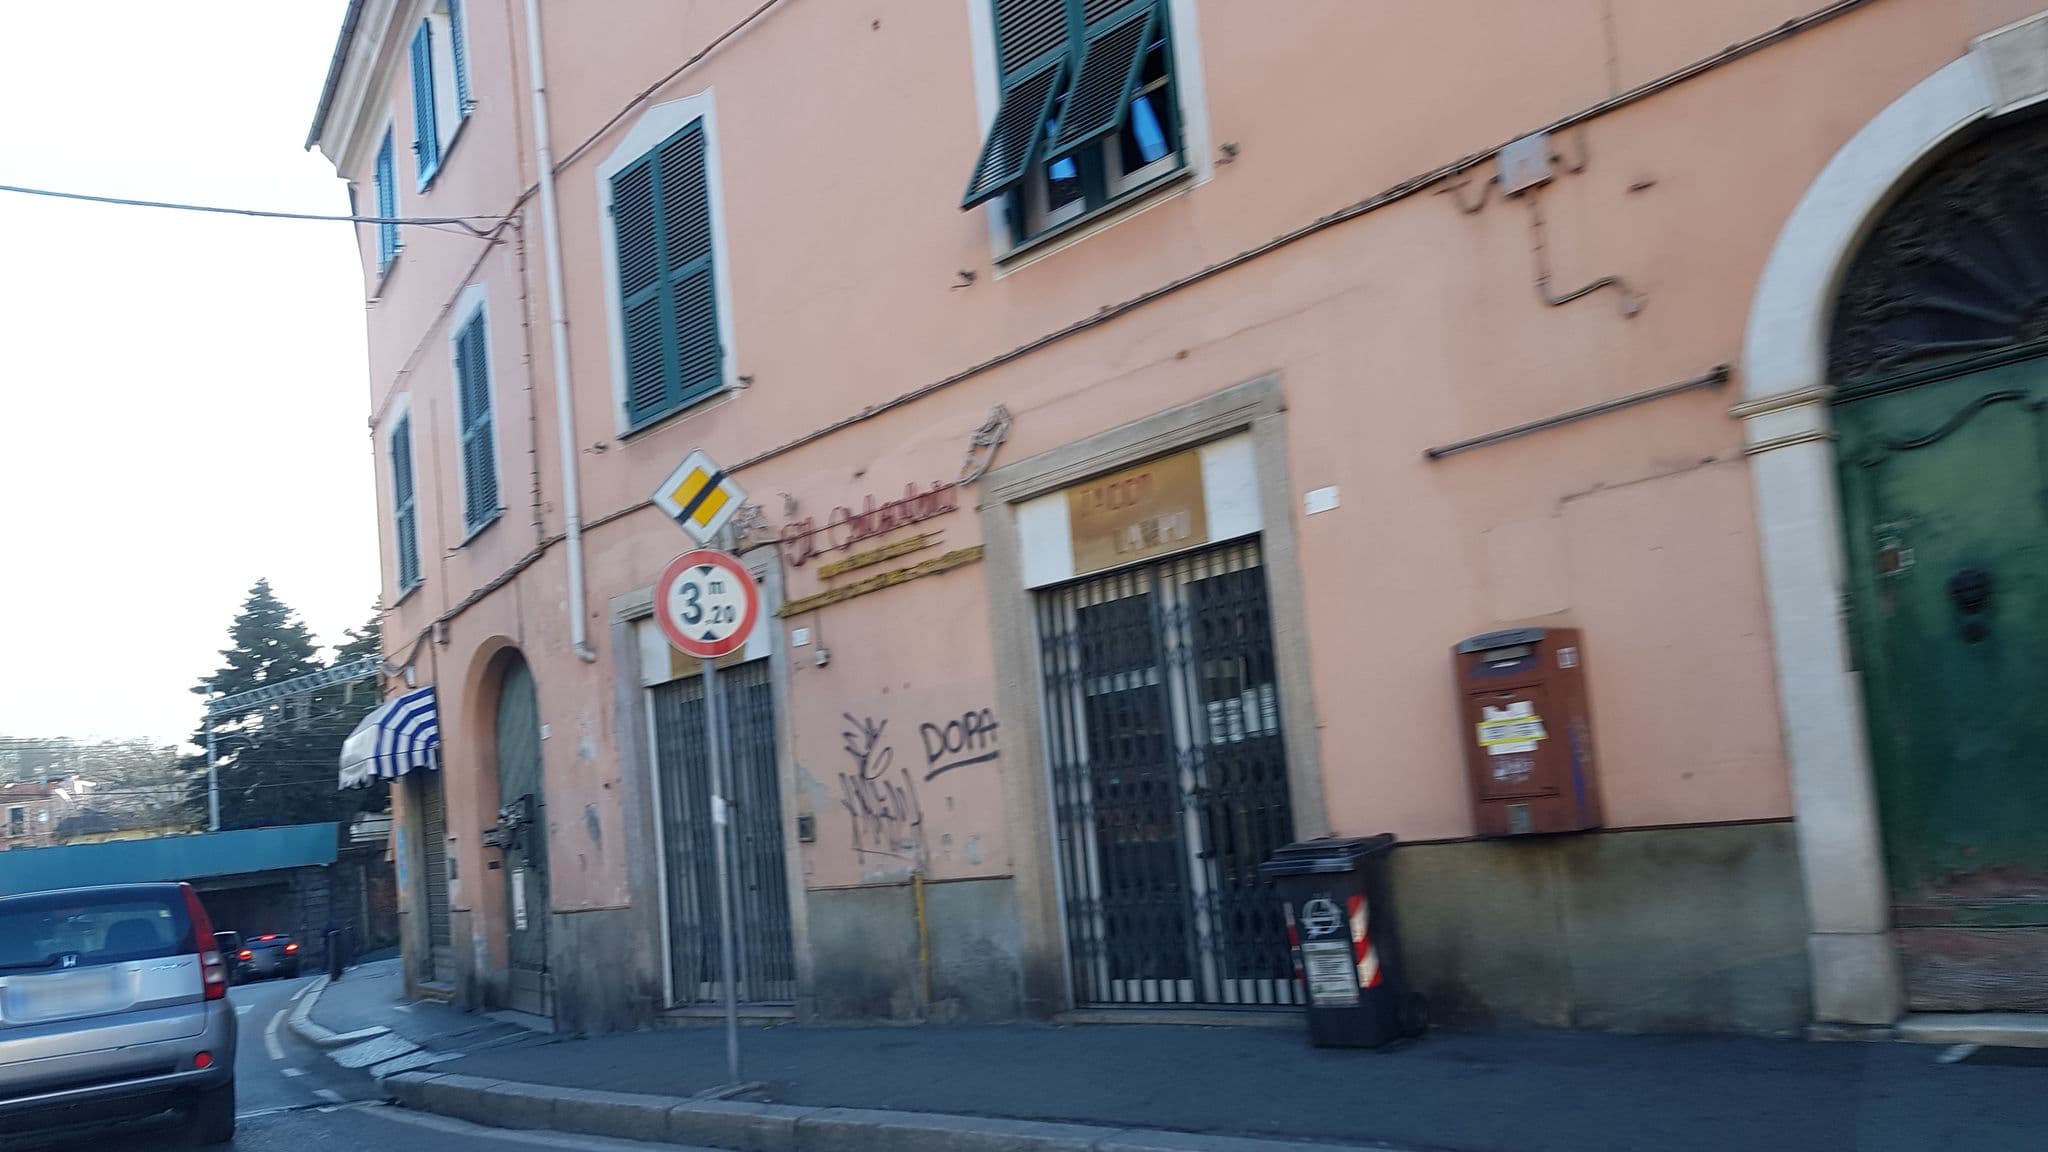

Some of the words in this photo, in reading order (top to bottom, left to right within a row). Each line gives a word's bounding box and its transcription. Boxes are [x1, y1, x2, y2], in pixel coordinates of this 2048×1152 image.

[679, 582, 702, 625] 3
[708, 581, 727, 595] m
[920, 708, 999, 765] DOPA
